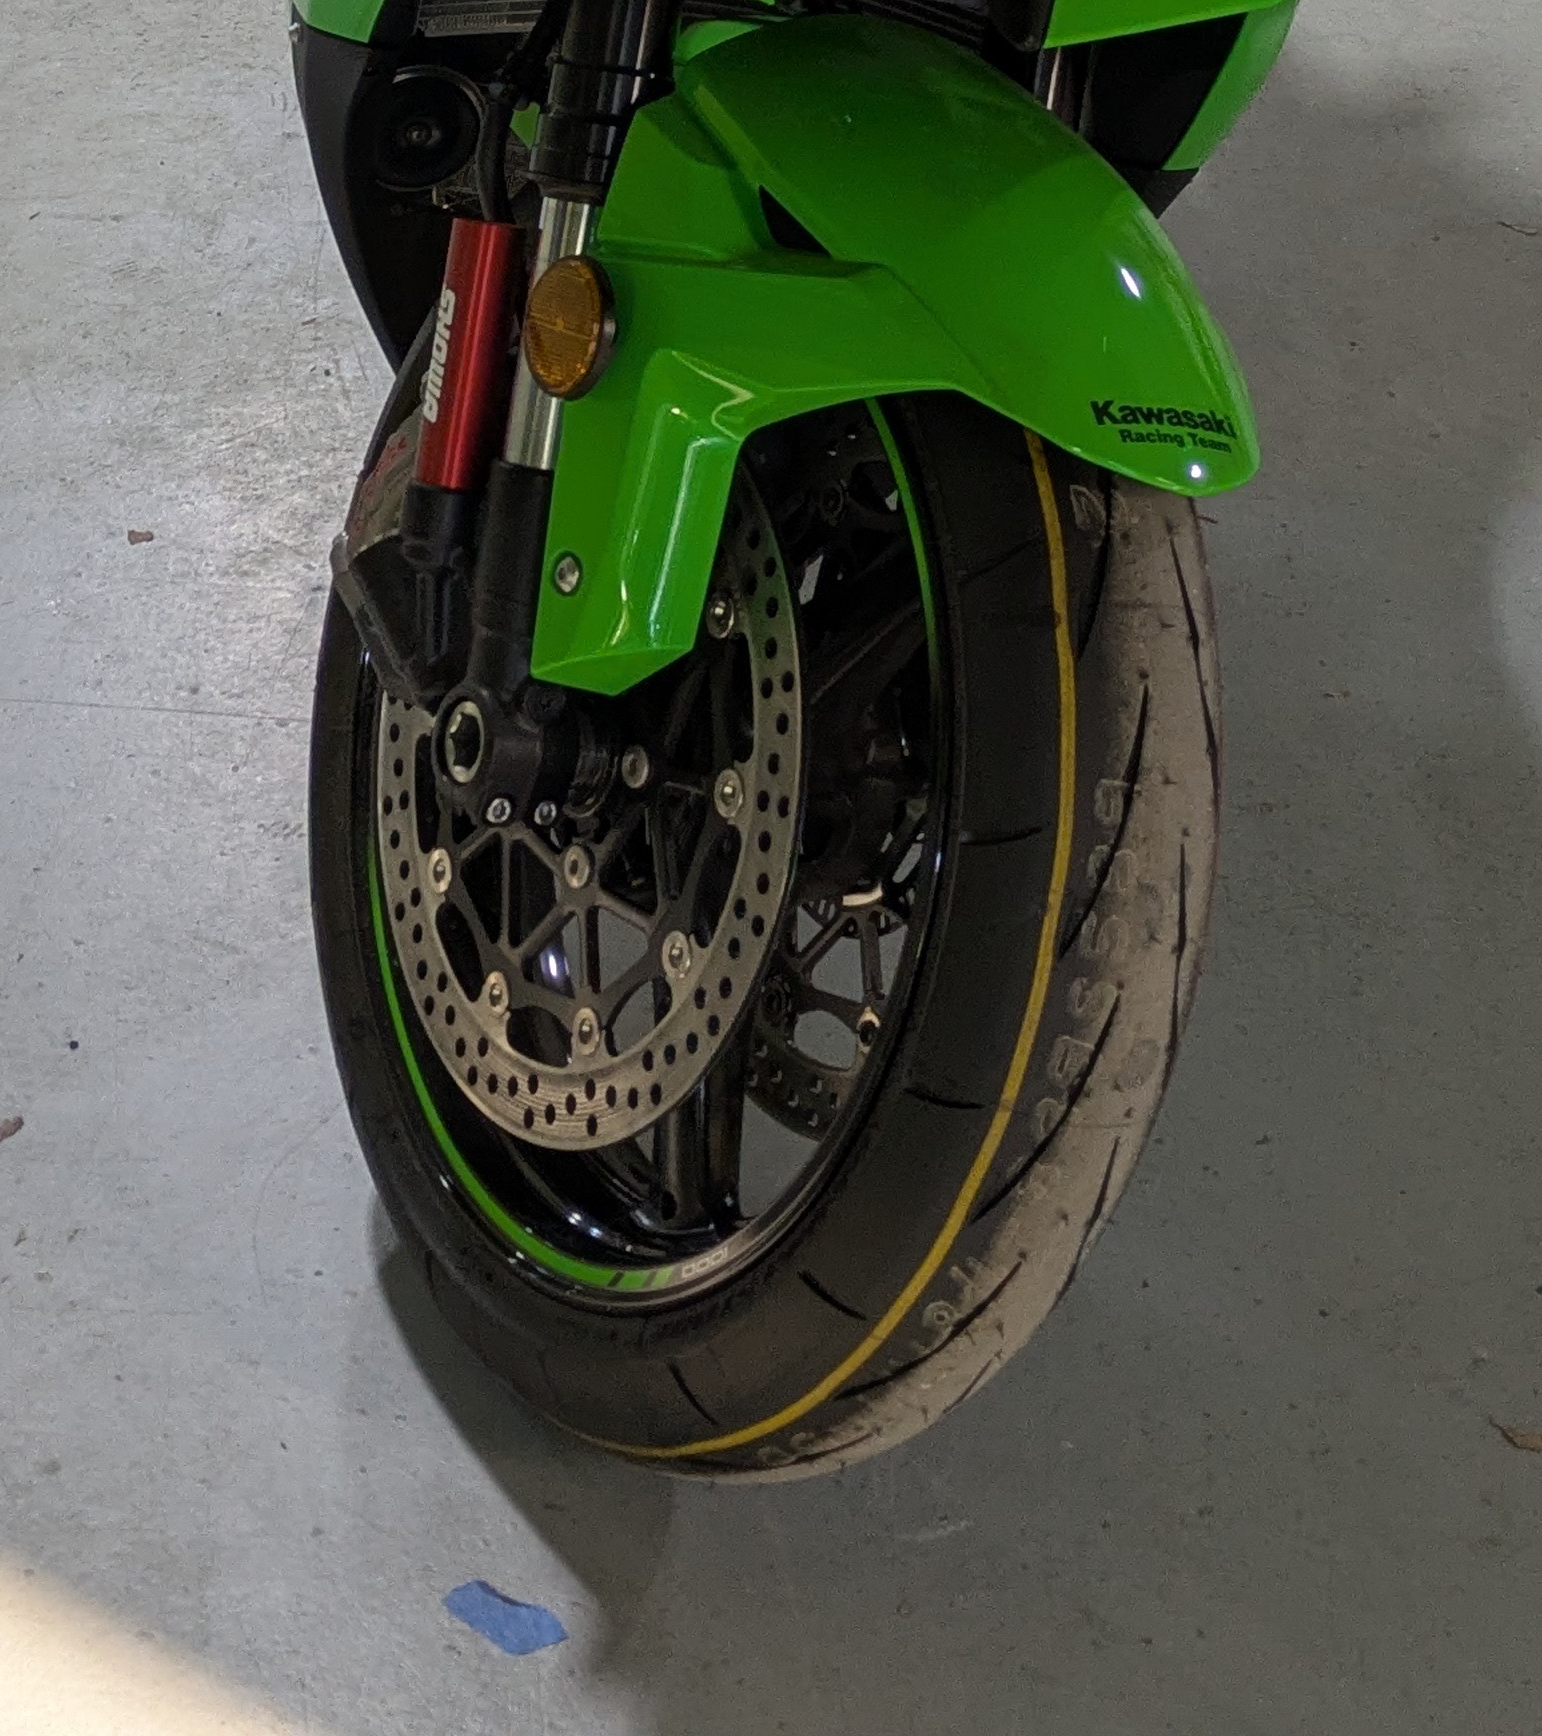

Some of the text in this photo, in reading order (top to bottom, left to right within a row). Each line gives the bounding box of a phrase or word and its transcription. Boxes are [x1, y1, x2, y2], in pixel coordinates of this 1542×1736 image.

[423, 287, 456, 424] SHOWA
[1090, 400, 1238, 440] Kawasaki
[1118, 428, 1233, 454] Racing Team
